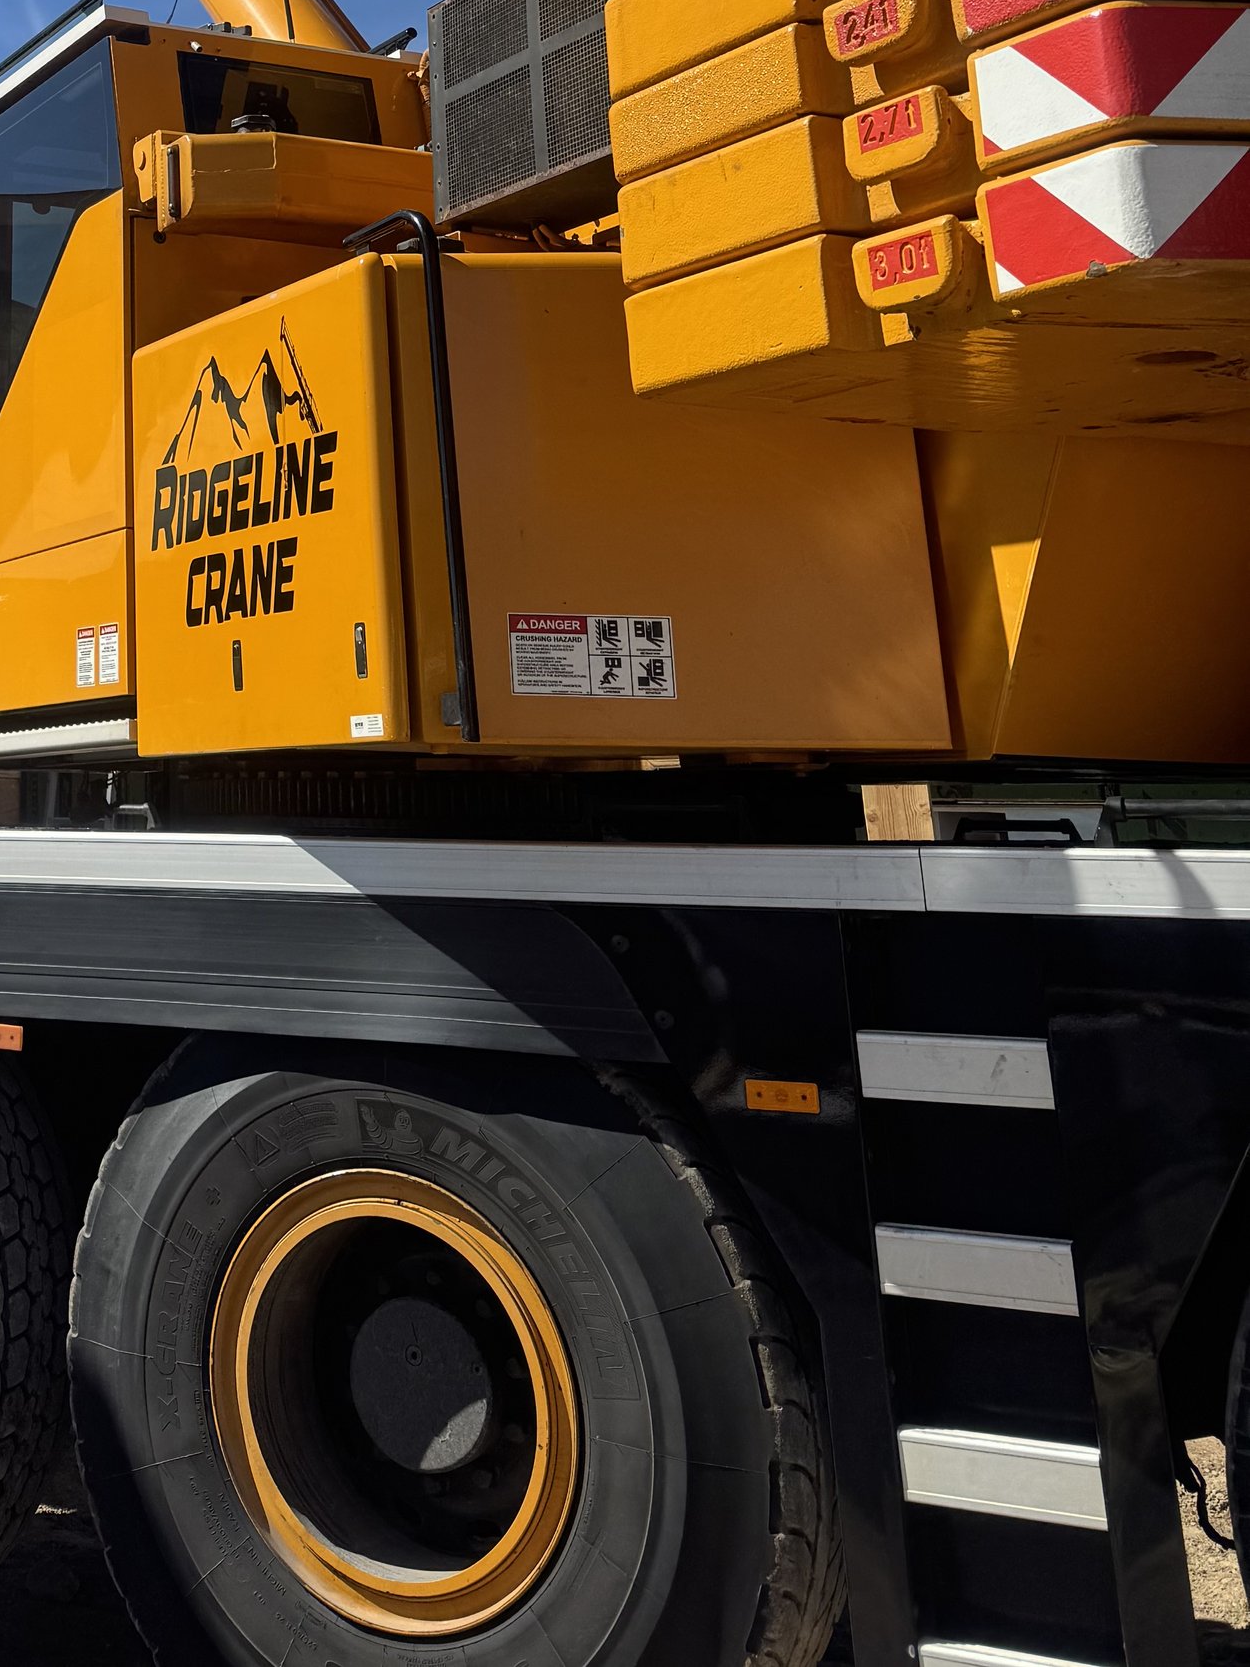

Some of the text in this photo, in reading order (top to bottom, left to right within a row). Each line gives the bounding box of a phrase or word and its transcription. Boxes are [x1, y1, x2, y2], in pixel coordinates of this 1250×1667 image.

[151, 431, 338, 552] RIDGELINE
[185, 536, 298, 628] CRANE
[530, 619, 581, 631] DANGER
[515, 634, 583, 643] CRUSHING HAZARD
[430, 1125, 632, 1390] MICHELIN
